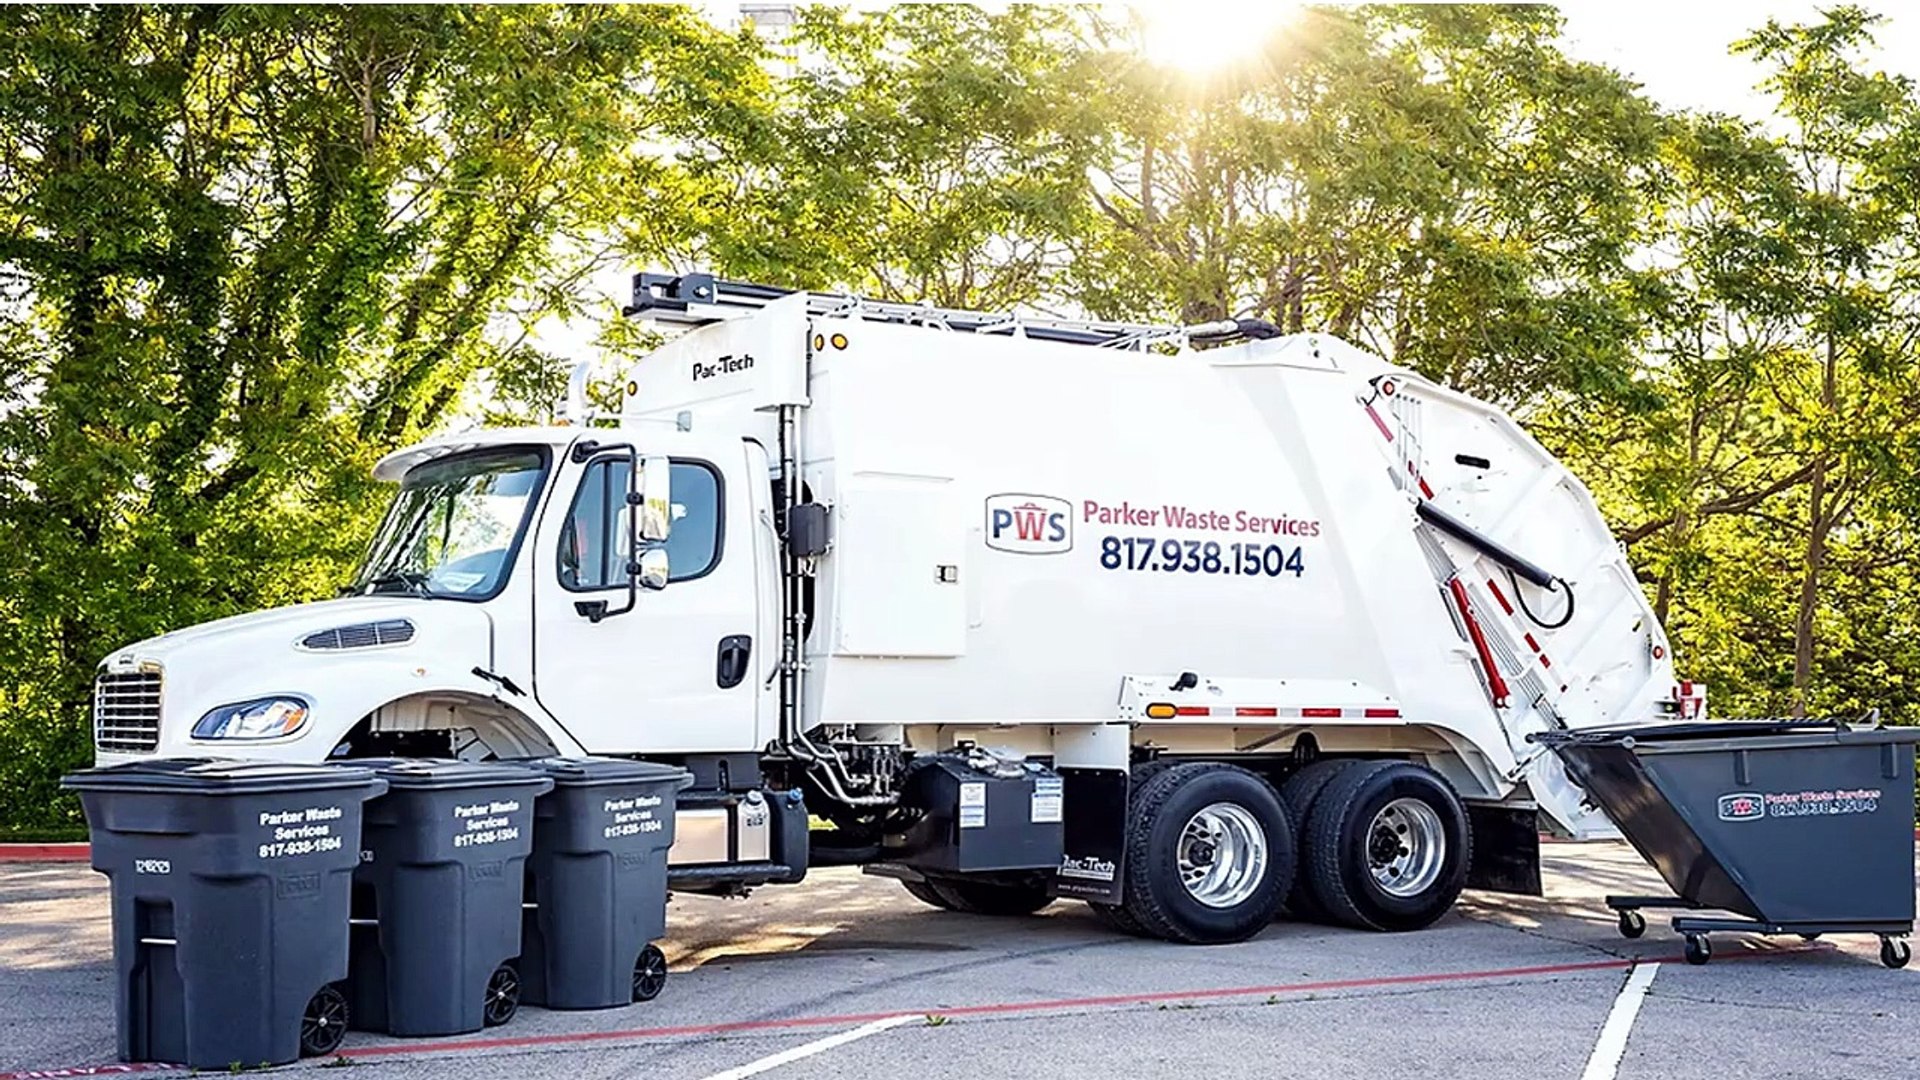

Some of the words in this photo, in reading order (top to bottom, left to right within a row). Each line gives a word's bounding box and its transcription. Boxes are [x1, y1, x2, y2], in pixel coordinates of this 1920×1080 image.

[692, 353, 754, 381] Pac-Tech
[992, 507, 1066, 543] PWS
[1083, 499, 1160, 528] Parker
[1162, 505, 1230, 532] Waste
[1235, 510, 1321, 537] Services
[1100, 535, 1305, 578] 817.938.1504
[260, 811, 304, 826] Parker
[305, 806, 342, 821] Waste
[454, 804, 489, 818] Parker
[489, 800, 519, 814] Waste
[604, 800, 634, 812] Parker
[466, 816, 508, 831] Services
[615, 810, 652, 823] Services
[274, 825, 329, 840] Services
[259, 836, 342, 858] 817-938-1504
